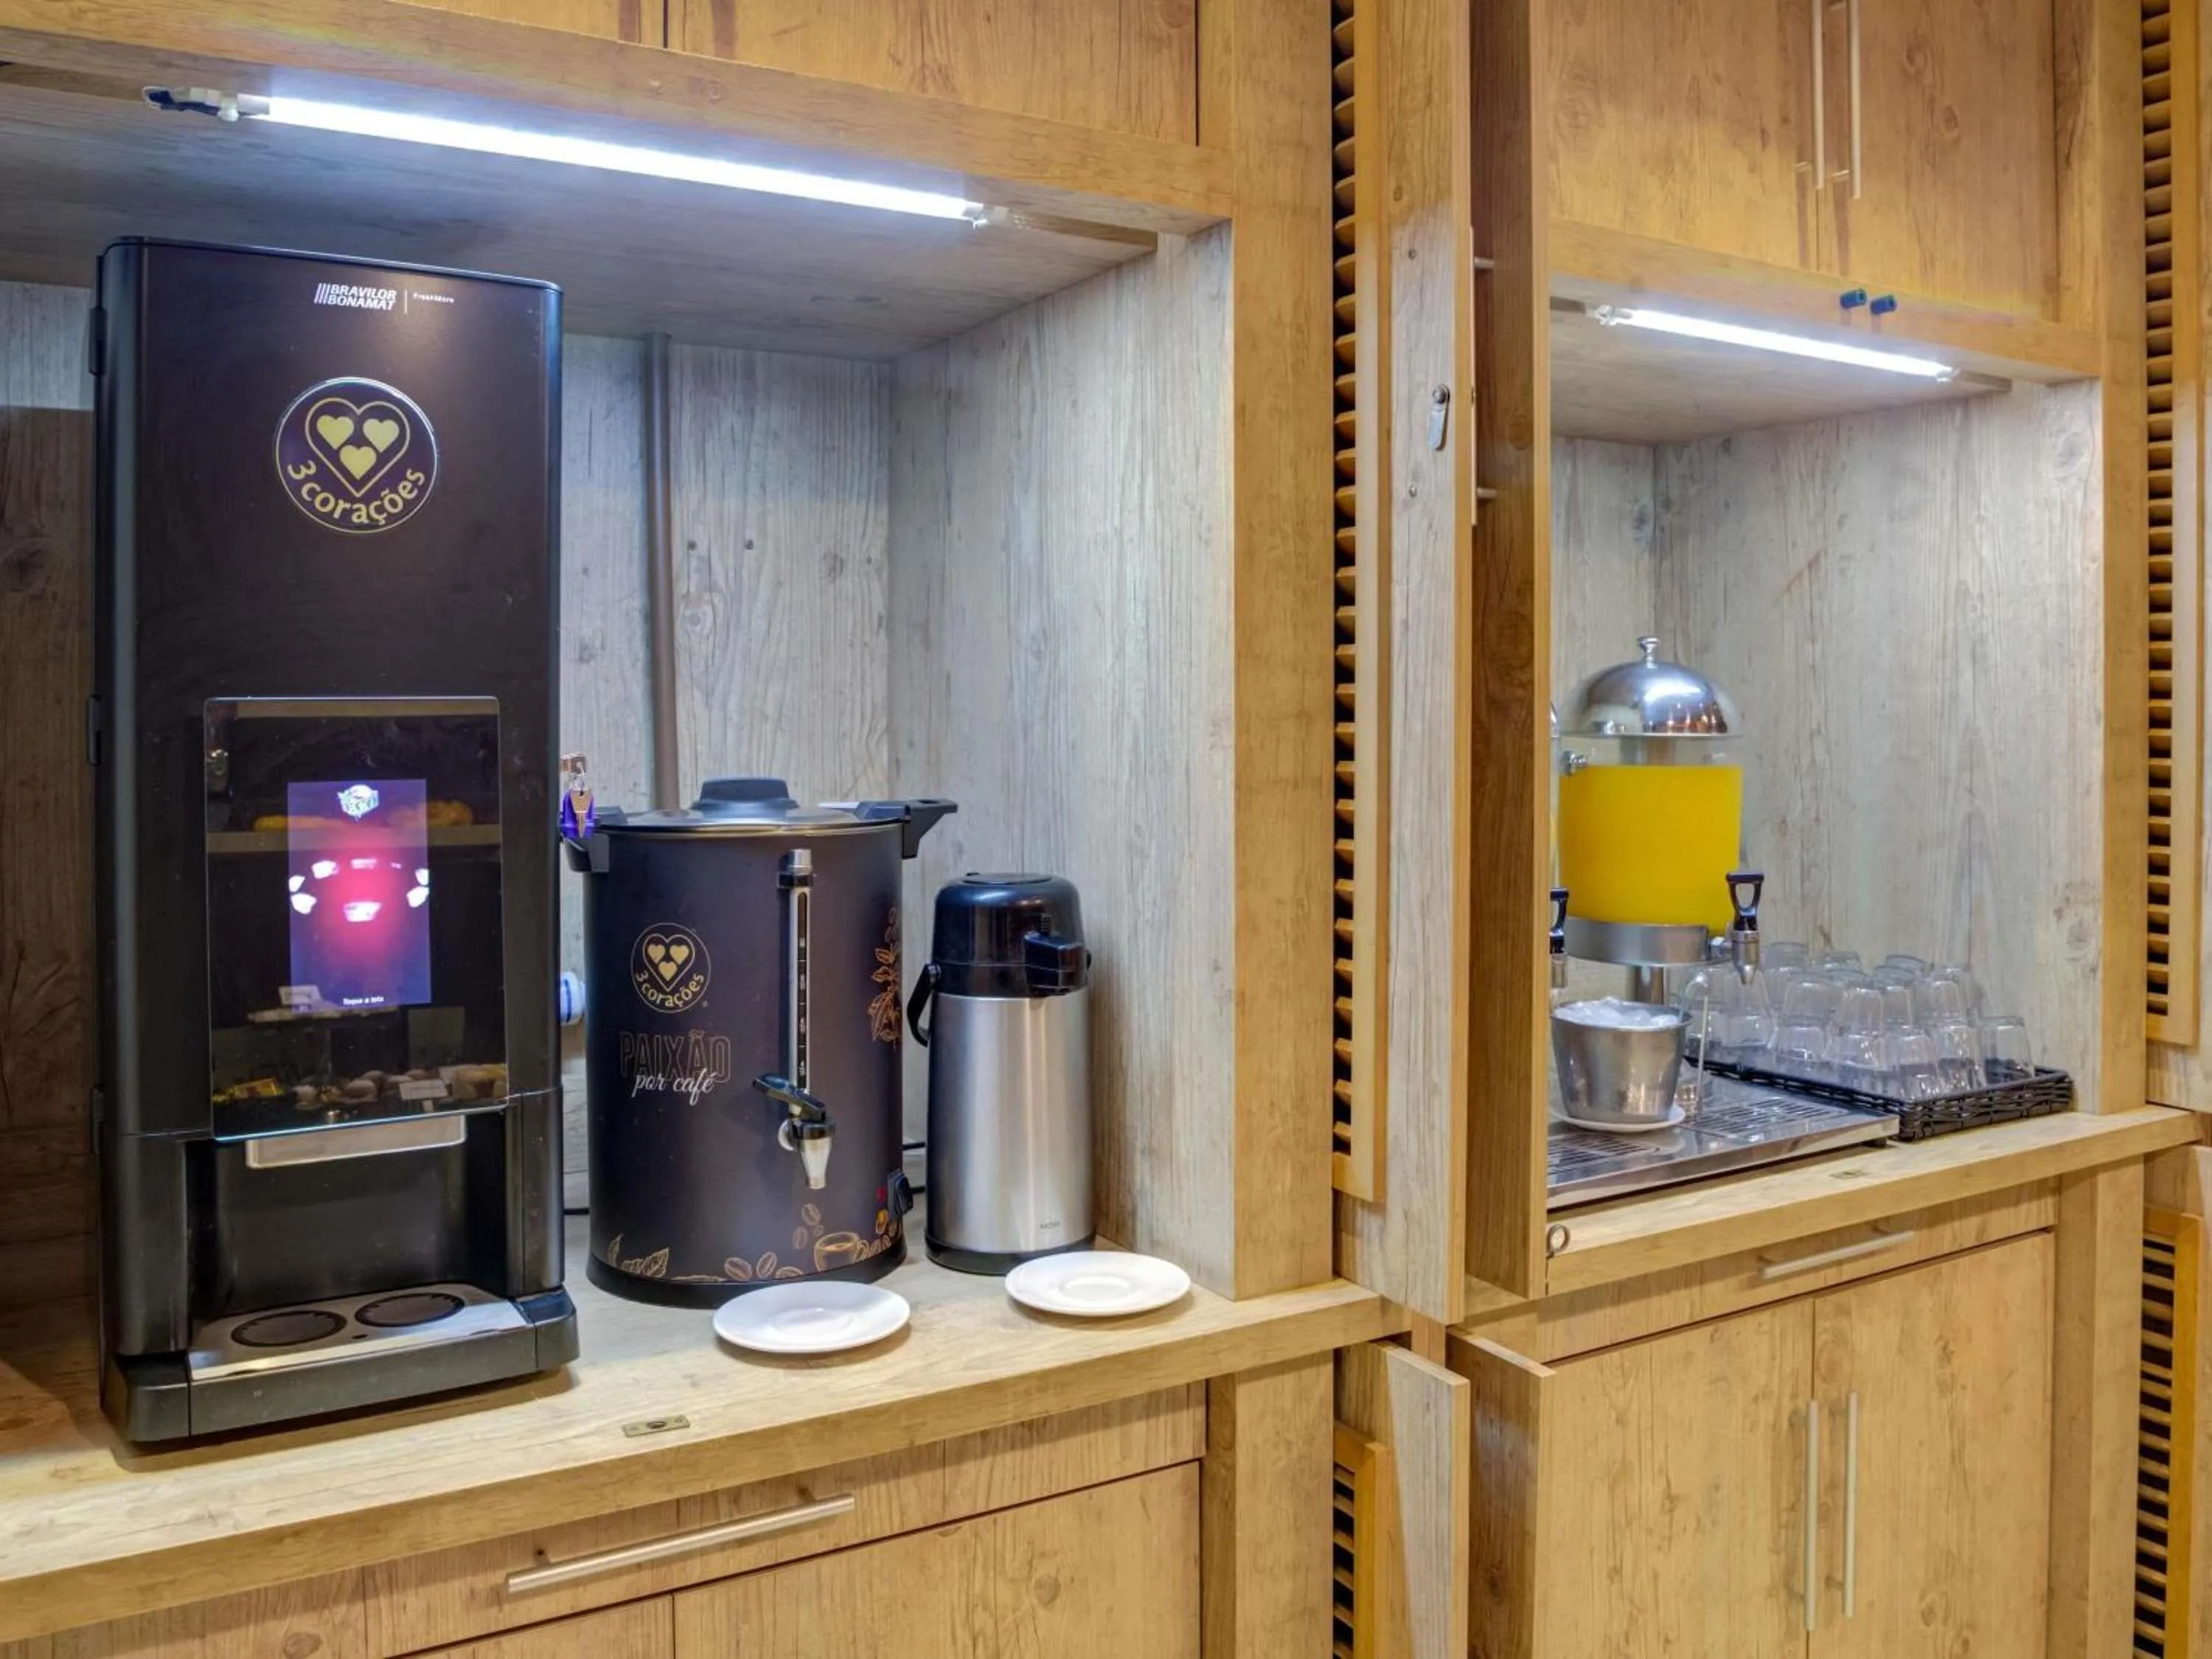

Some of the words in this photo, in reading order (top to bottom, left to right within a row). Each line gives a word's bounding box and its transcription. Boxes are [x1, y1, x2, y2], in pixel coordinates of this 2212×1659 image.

[327, 294, 395, 310] BONAMAT
[330, 283, 397, 302] BRAVILOR
[287, 459, 317, 480] 3
[300, 467, 425, 525] corações
[636, 970, 649, 982] 3
[641, 973, 704, 1007] corações
[620, 1029, 731, 1083] PAIXÃO
[631, 1073, 667, 1098] por
[672, 1068, 720, 1106] café
